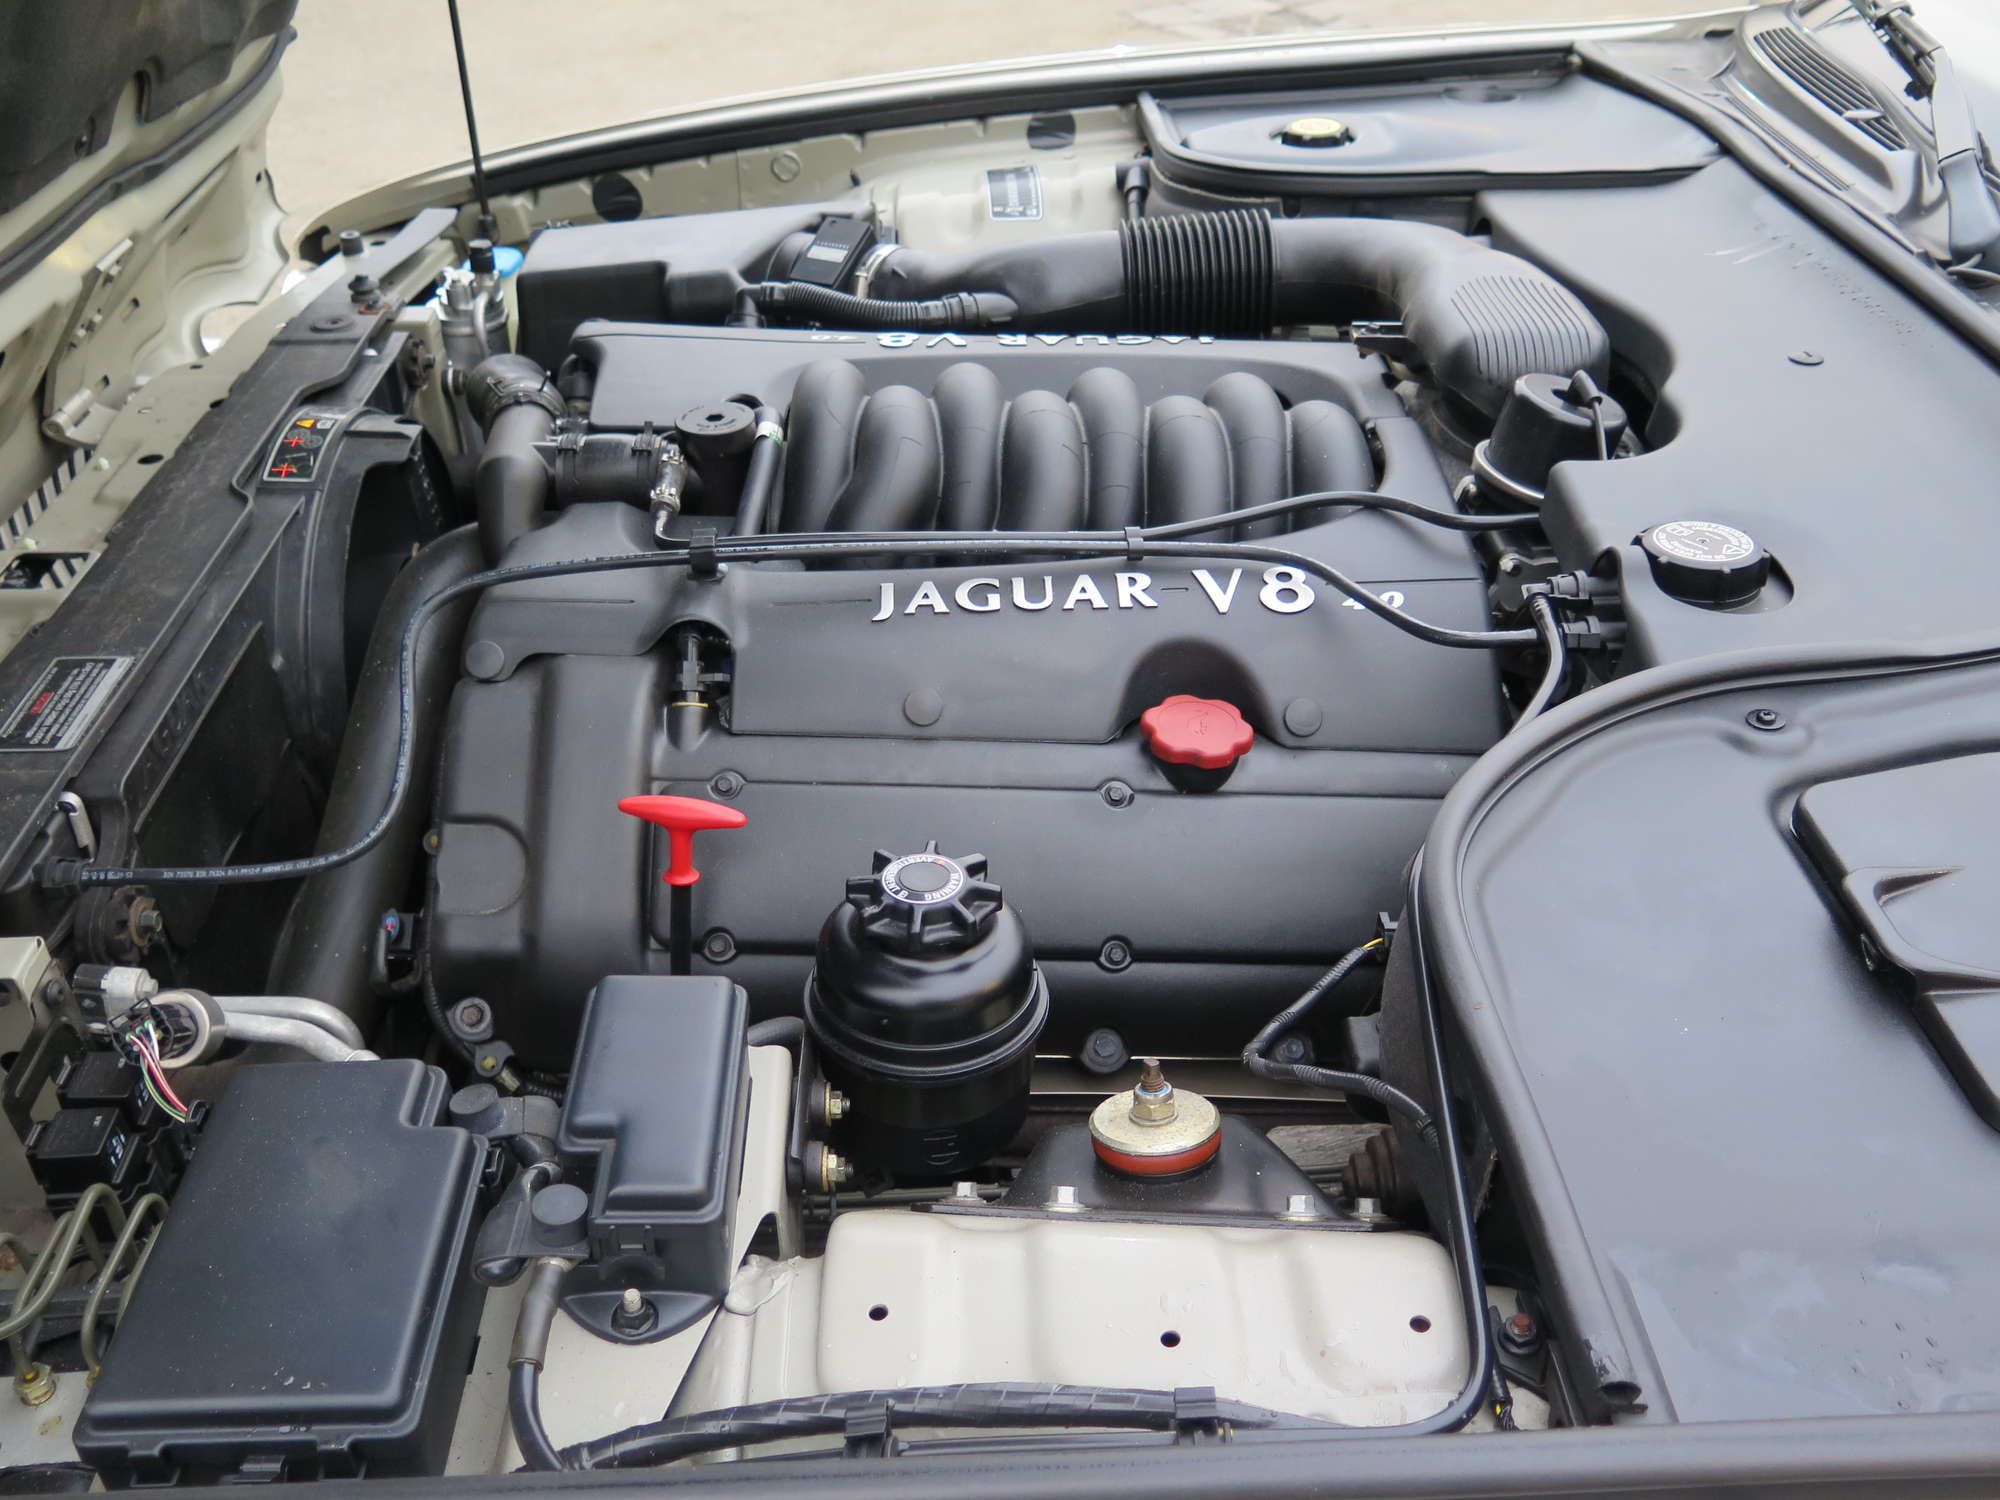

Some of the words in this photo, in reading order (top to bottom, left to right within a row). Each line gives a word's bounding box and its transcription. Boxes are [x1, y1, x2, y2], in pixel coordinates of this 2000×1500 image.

[876, 332, 967, 348] V8
[871, 571, 1159, 622] JAGUAR
[1191, 565, 1316, 615] V8
